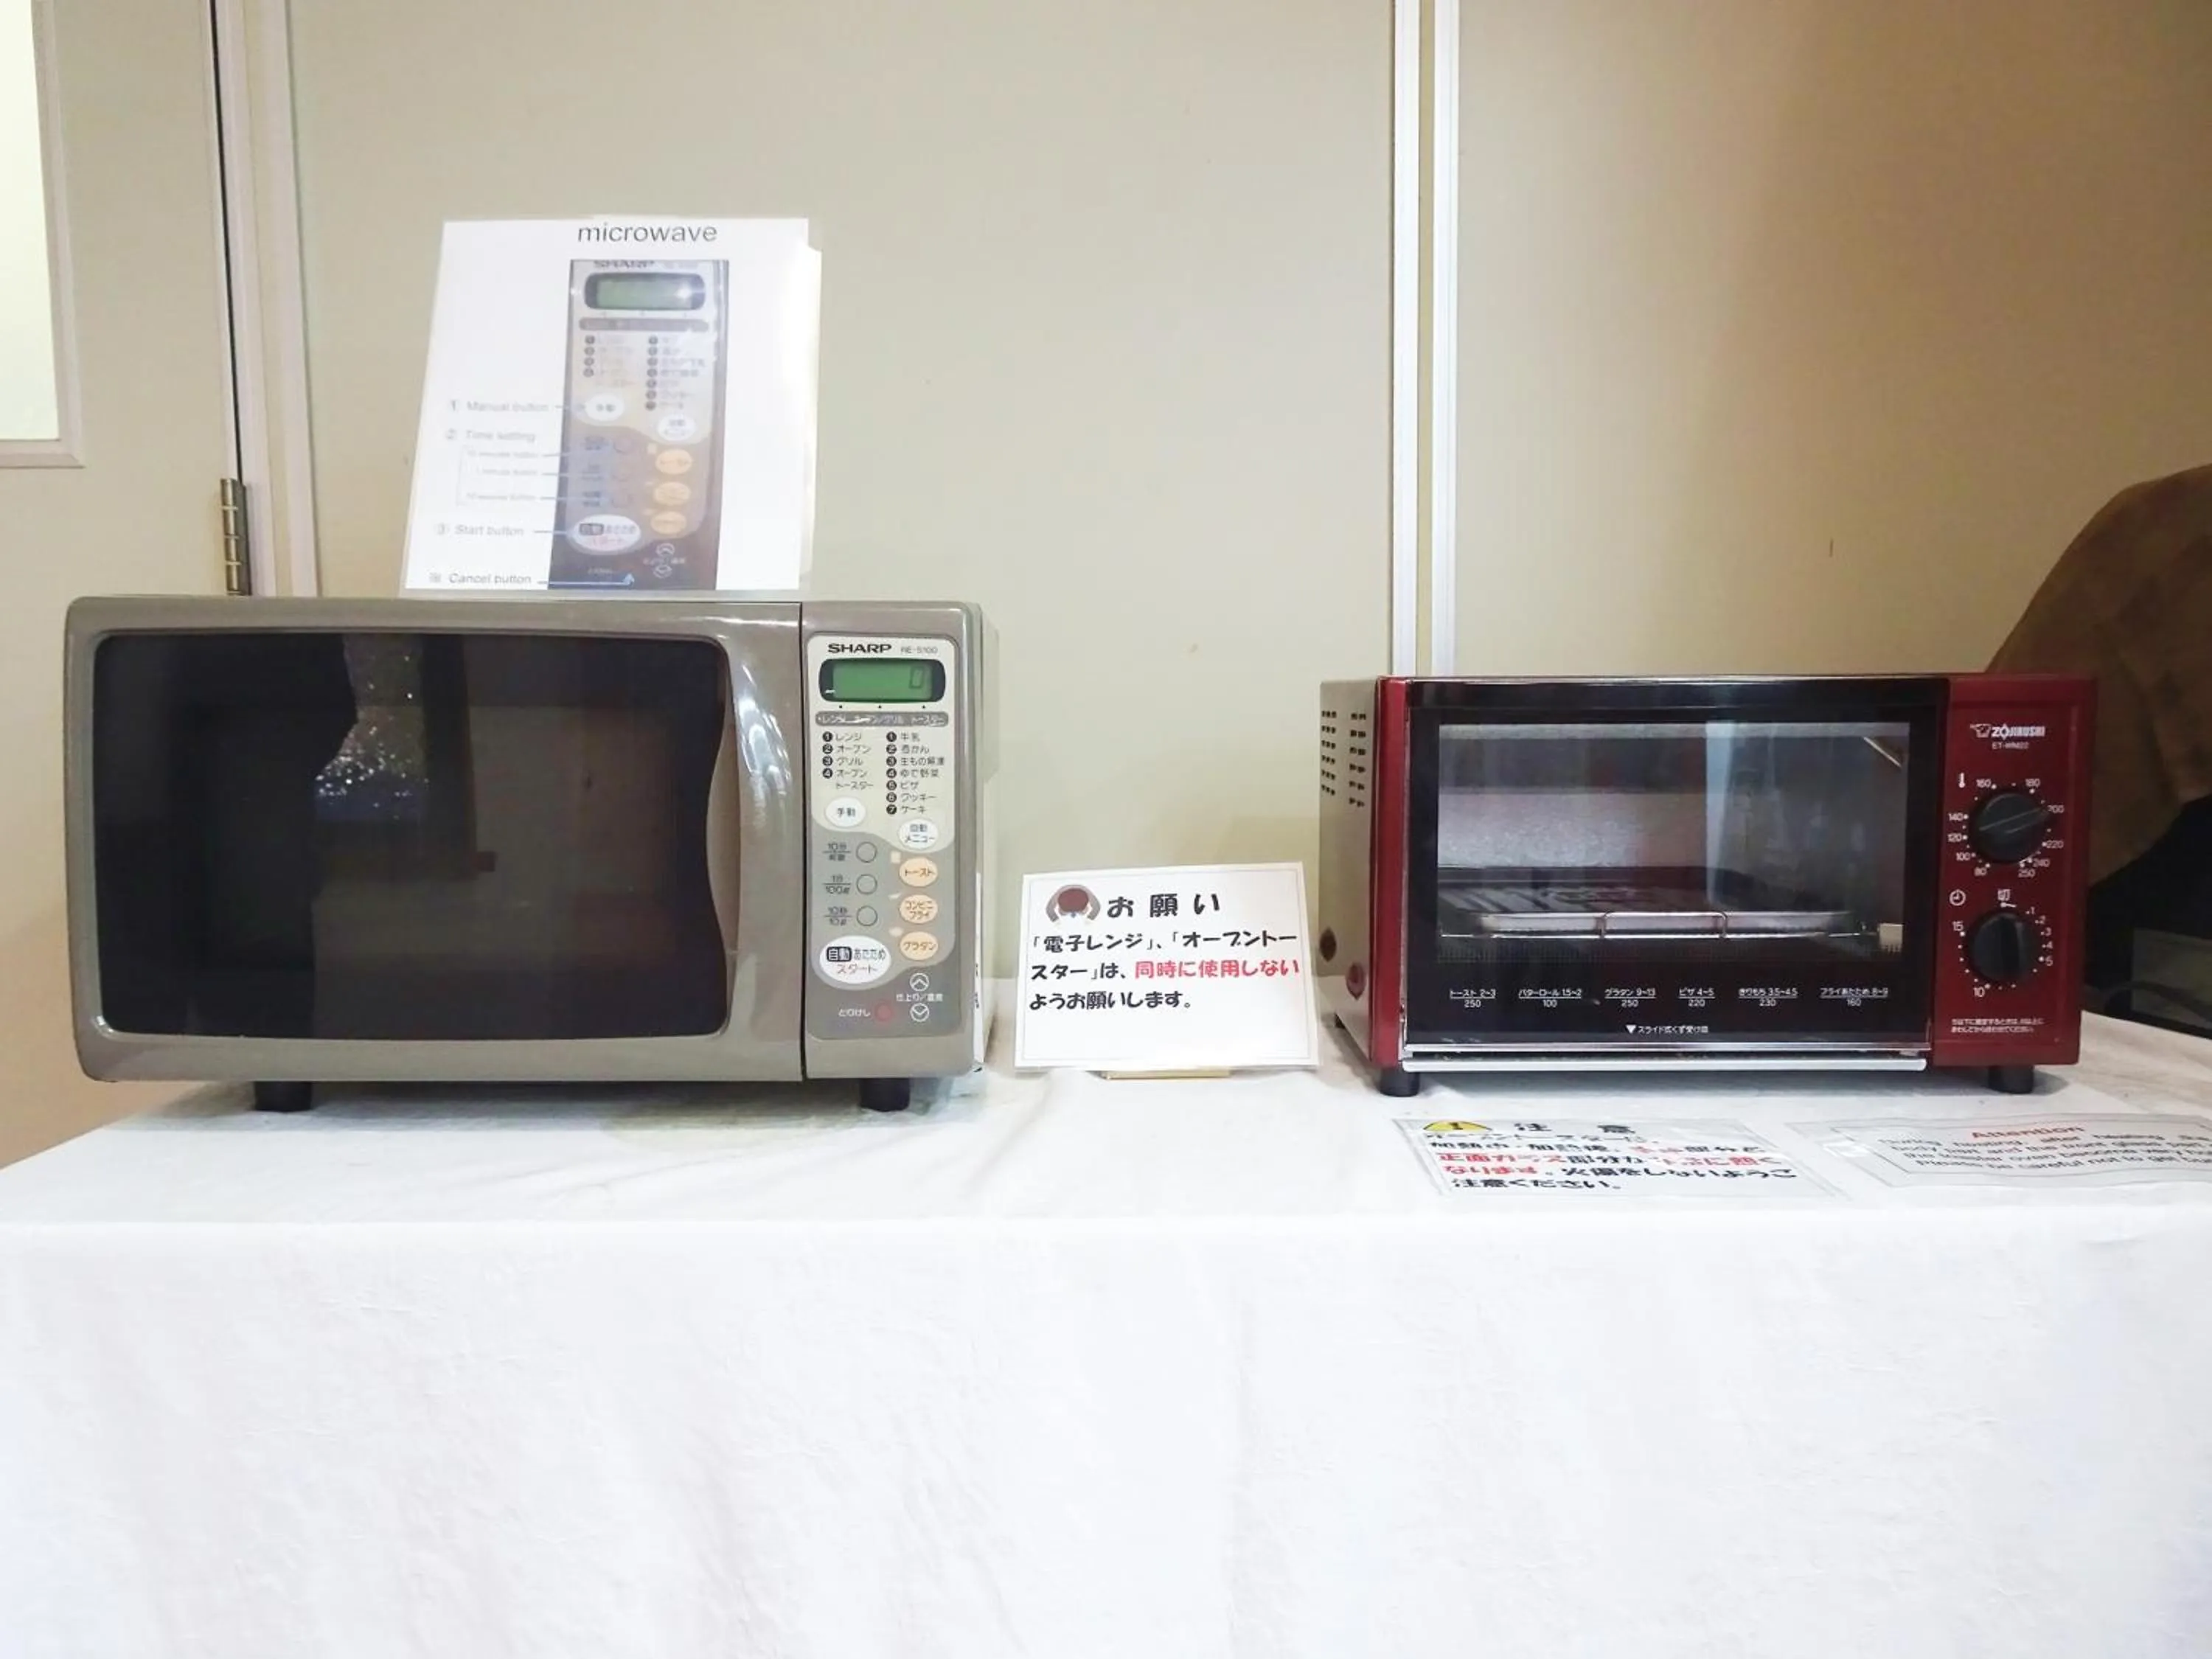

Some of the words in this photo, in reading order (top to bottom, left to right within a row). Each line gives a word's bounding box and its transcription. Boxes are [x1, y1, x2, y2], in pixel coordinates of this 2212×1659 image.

[577, 223, 717, 243] microwave
[467, 400, 509, 412] Manual
[512, 400, 549, 412] button
[465, 430, 493, 440] Time
[455, 524, 486, 536] Start
[490, 525, 524, 537] button
[449, 573, 493, 584] Cancel
[495, 574, 532, 585] button
[827, 644, 892, 654] SHARP
[909, 667, 925, 689] 0
[835, 733, 862, 741] レンジ
[901, 732, 920, 742] 牛乳
[836, 745, 872, 754] オーブン
[836, 757, 863, 765] グリル
[901, 757, 945, 767] 生もの解凍
[836, 770, 868, 778] オーブン
[901, 768, 939, 779] ゆで野菜
[835, 781, 874, 790] トースター
[900, 781, 919, 790] ピザ
[901, 793, 939, 803] クッキー
[836, 807, 856, 818] 手動
[901, 805, 927, 815] ケーキ
[910, 824, 927, 832] 自動
[904, 834, 935, 843] メニュー
[1948, 834, 1962, 842] 120
[1956, 852, 1971, 860] 100
[905, 868, 935, 877] トースト
[905, 901, 934, 910] コンビニ
[1952, 921, 1964, 931] 15
[2045, 928, 2052, 936] 3
[903, 941, 936, 951] グラタン
[1033, 930, 1297, 953] 「電子レンジ」、「オーブントー
[2046, 941, 2053, 949] 4
[829, 948, 849, 959] 自動
[854, 948, 886, 959] あたため
[2045, 957, 2053, 966] 5
[837, 964, 877, 974] スタート
[1031, 959, 1299, 981] スター」は、同時に使用しない
[1604, 987, 1634, 996] グラタン
[1973, 987, 1985, 998] 10
[1029, 991, 1192, 1011] ようお願いします。
[1464, 999, 1481, 1008] 250
[1543, 999, 1558, 1008] 100
[1621, 999, 1638, 1007] 250
[1688, 999, 1705, 1007] 220
[838, 1007, 871, 1018] とりけし
[1972, 1127, 2085, 1138] Attention
[2018, 1160, 2084, 1169] careful
[2086, 1155, 2121, 1164] not
[1452, 1179, 1622, 1189] 注意ください。
